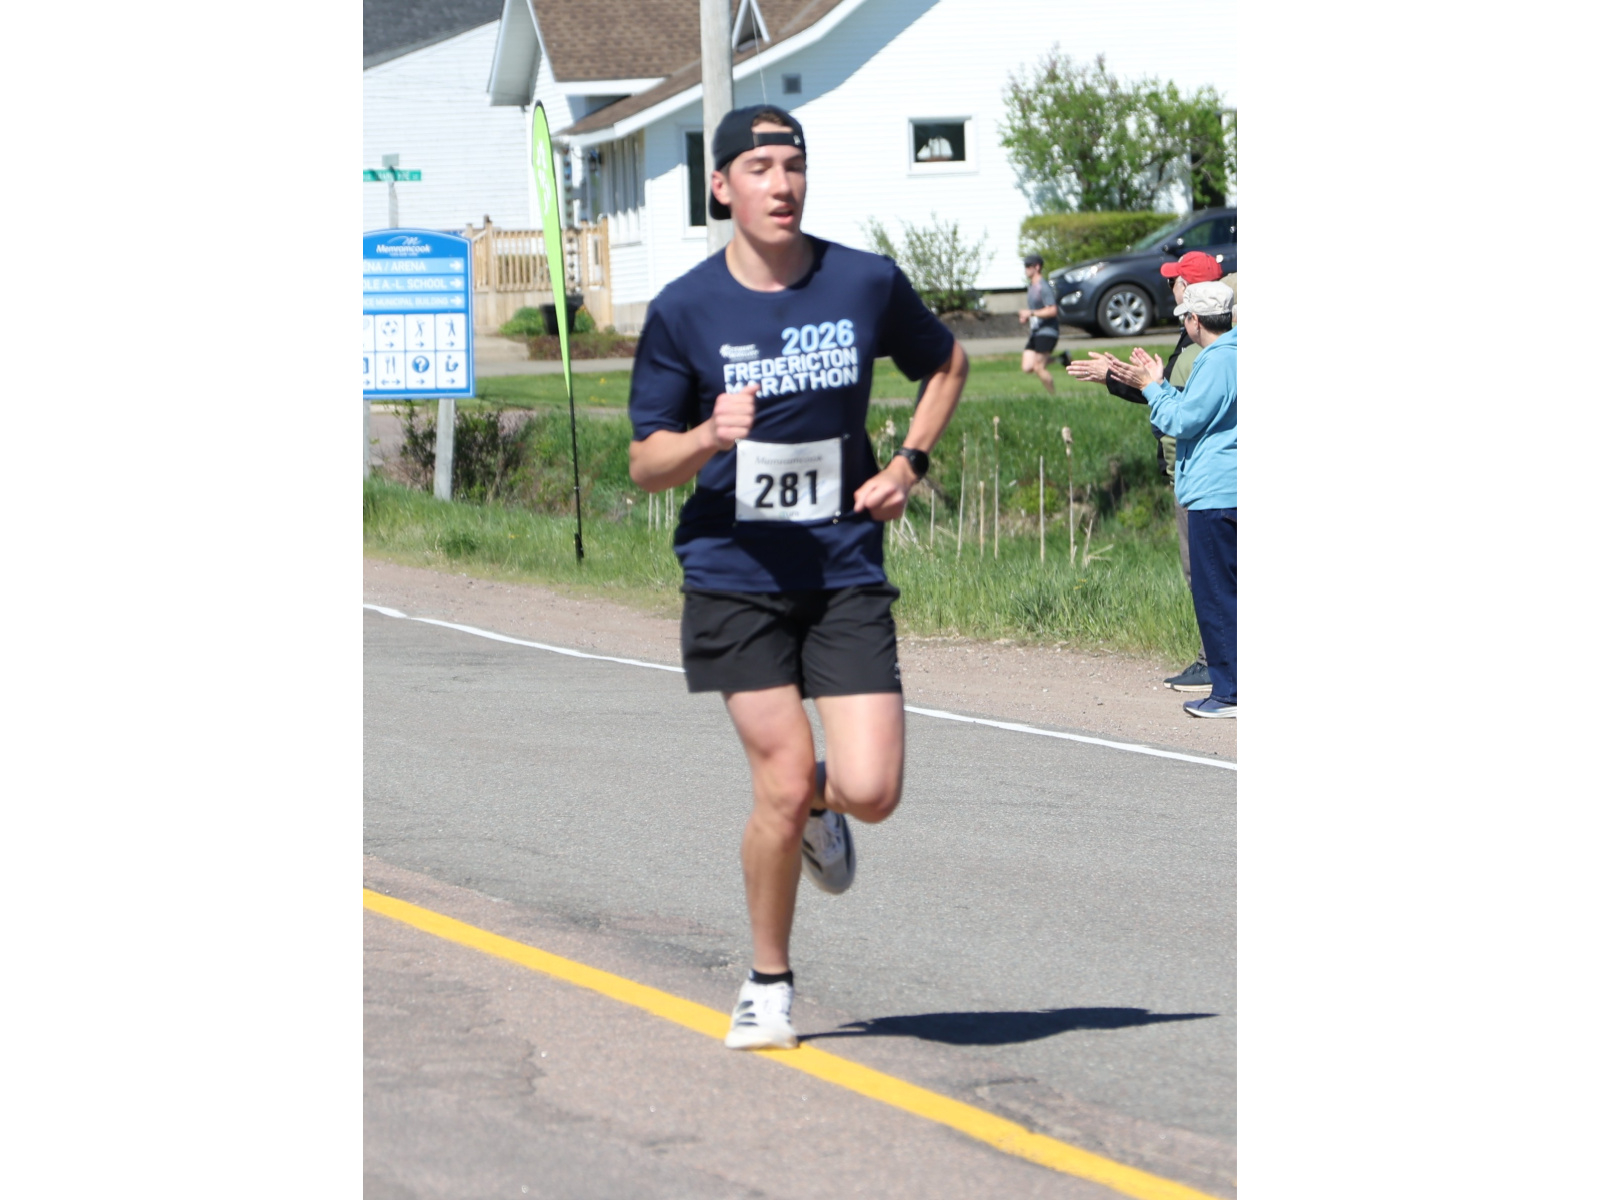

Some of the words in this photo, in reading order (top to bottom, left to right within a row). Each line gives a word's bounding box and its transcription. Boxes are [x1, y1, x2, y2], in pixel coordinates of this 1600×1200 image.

[376, 244, 431, 253] Memramcook
[391, 260, 426, 272] ARENA
[407, 278, 447, 290] SCHOOL
[375, 297, 413, 305] MUNICIPAL
[415, 297, 449, 305] BUILDING
[781, 319, 855, 356] 2026
[723, 346, 858, 383] FREDERICTON
[754, 470, 818, 508] 281
